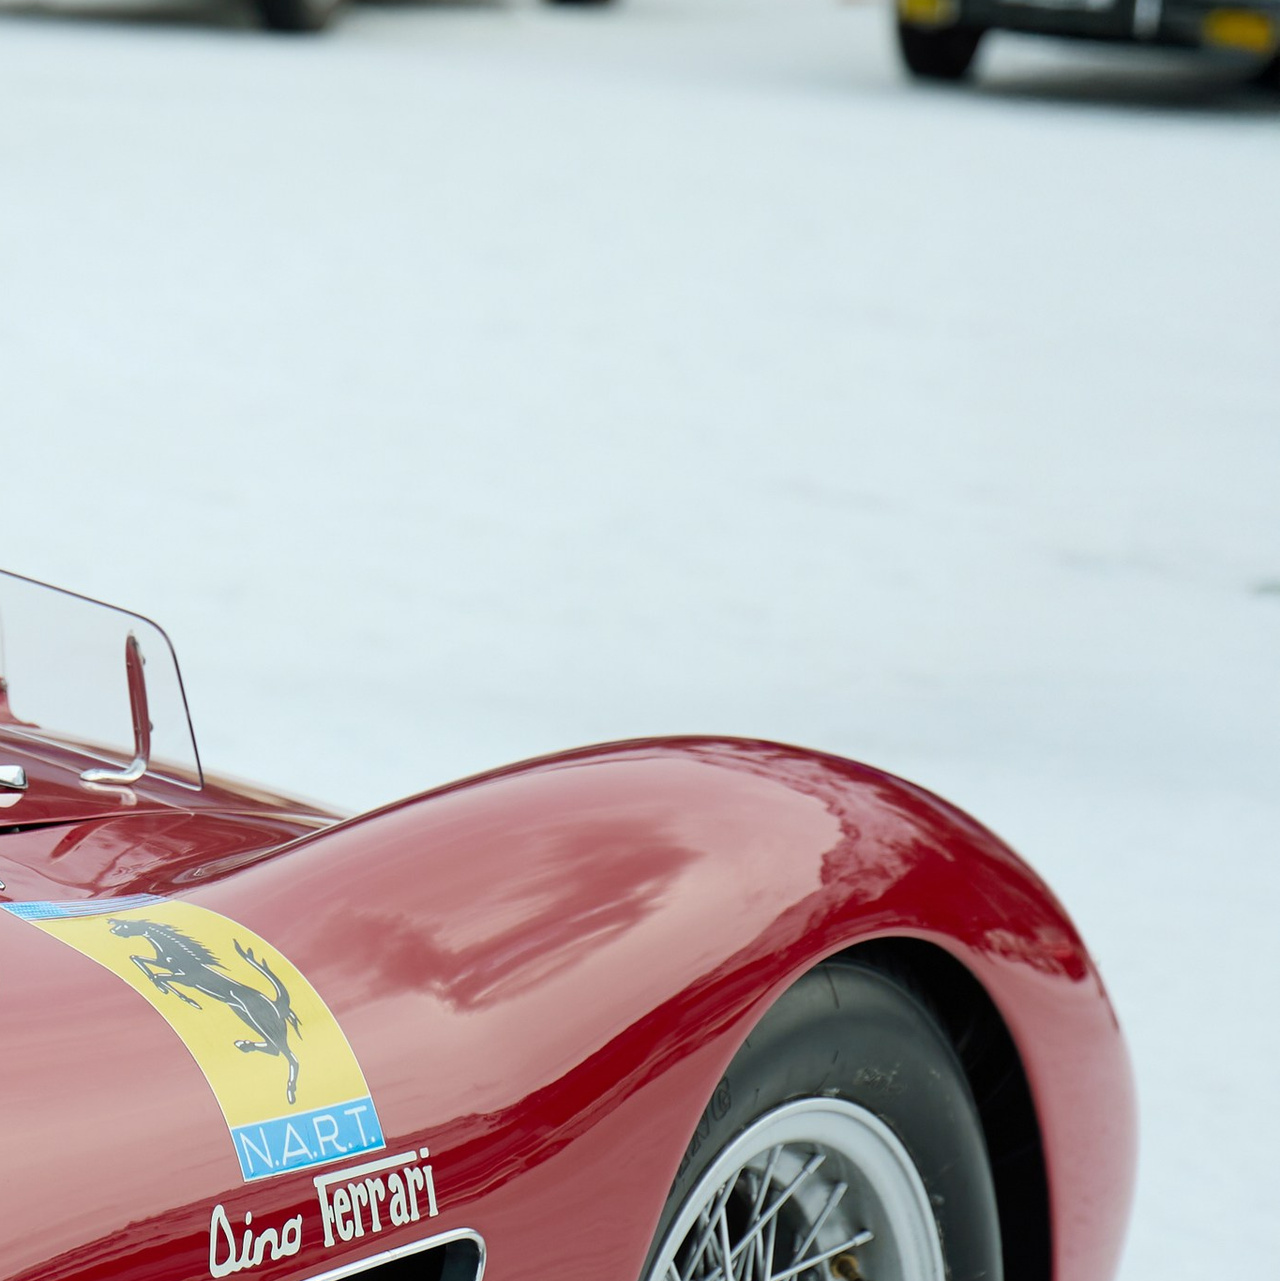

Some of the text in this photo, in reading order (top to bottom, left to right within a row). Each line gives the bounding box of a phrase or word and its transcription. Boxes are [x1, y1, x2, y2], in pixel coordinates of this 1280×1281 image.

[239, 1105, 376, 1173] N.A.R.T.
[209, 1147, 439, 1279] Dino Ferrari
